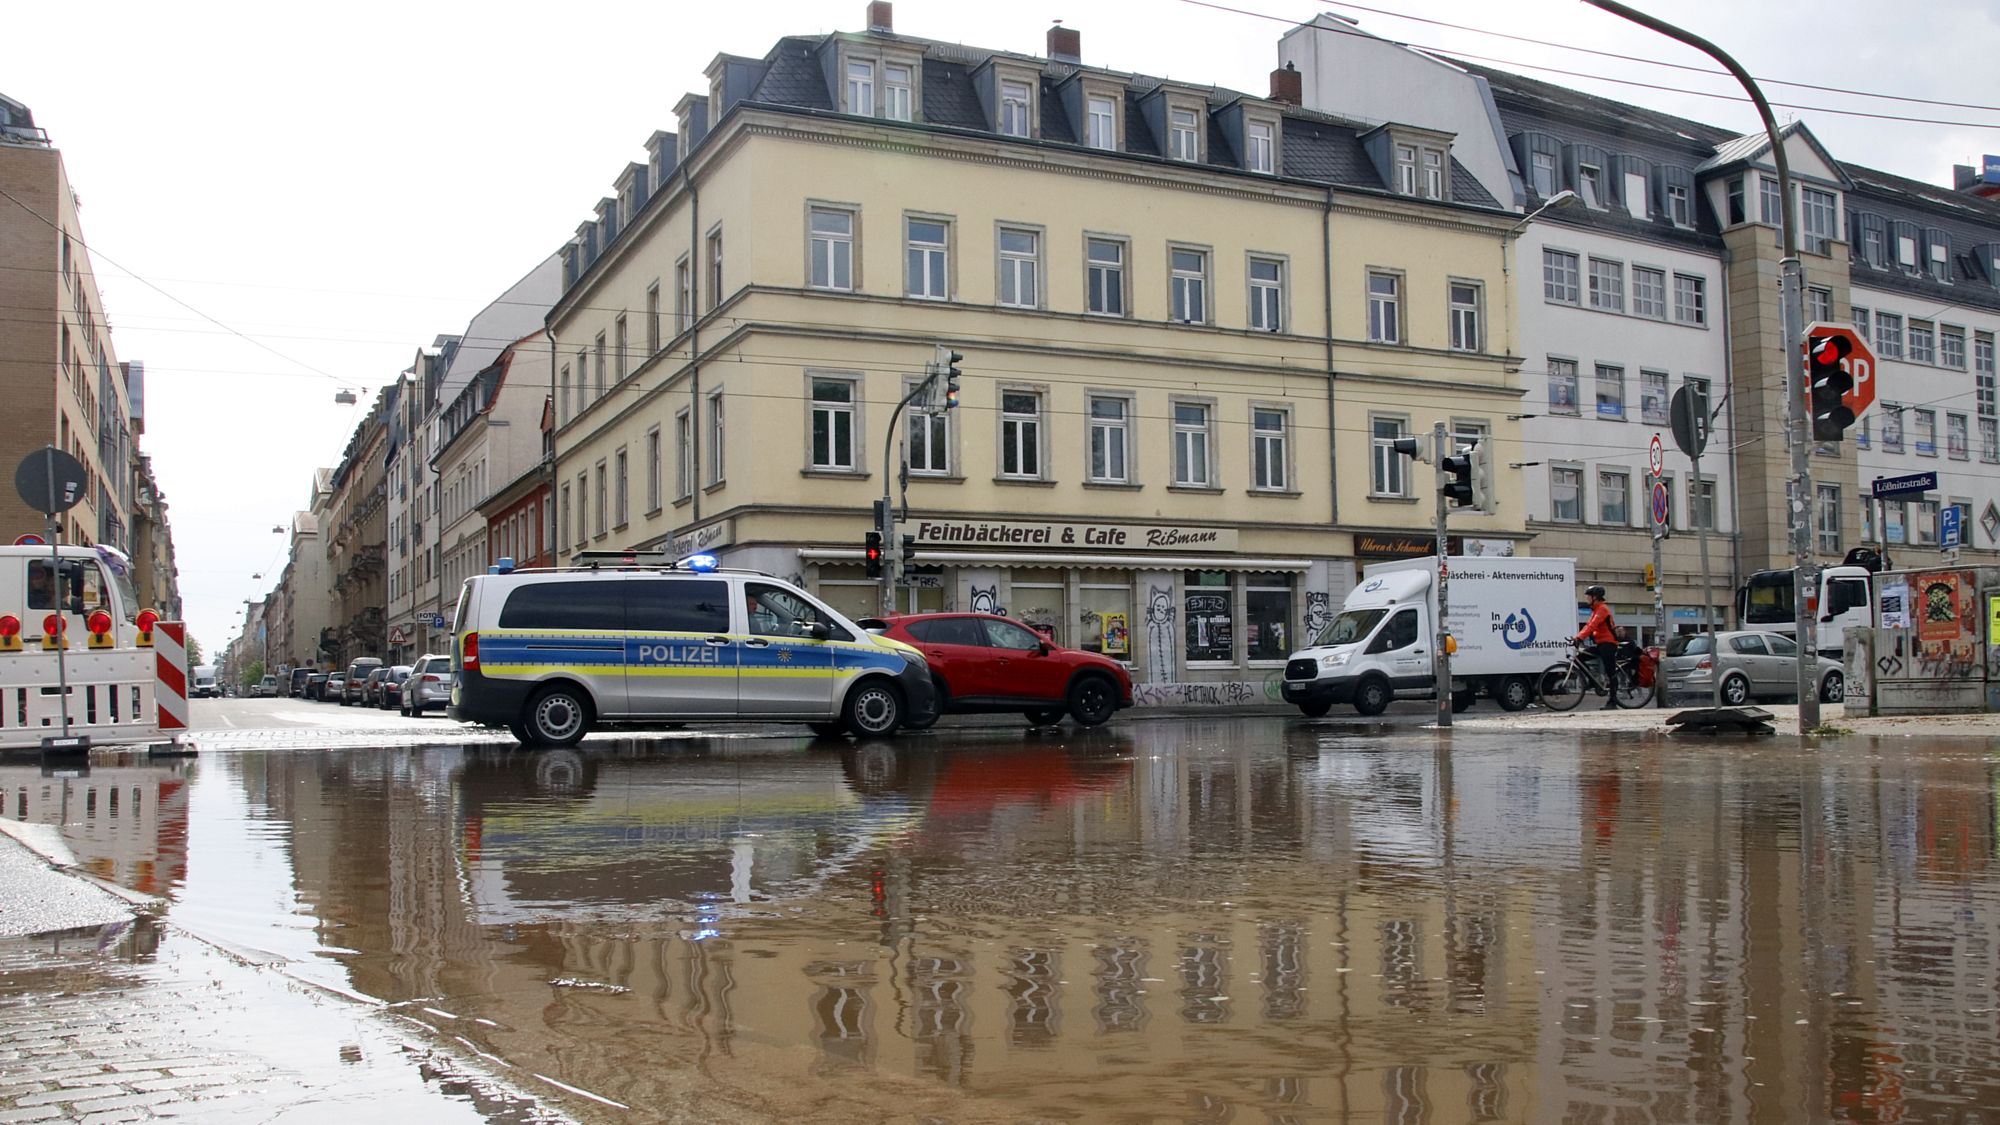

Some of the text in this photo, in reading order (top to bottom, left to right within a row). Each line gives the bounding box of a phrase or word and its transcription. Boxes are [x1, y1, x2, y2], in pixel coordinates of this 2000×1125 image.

[1876, 477, 1932, 493] Lößnitzstraße
[1943, 510, 1952, 526] P
[918, 522, 1217, 547] Feinbäckerei & Cafe Rißmann
[1492, 571, 1564, 582] Aktenvernichtung
[1491, 611, 1501, 621] In
[1491, 621, 1525, 632] puncto
[1520, 639, 1567, 649] Werkstätten
[639, 645, 719, 663] POLIZEI
